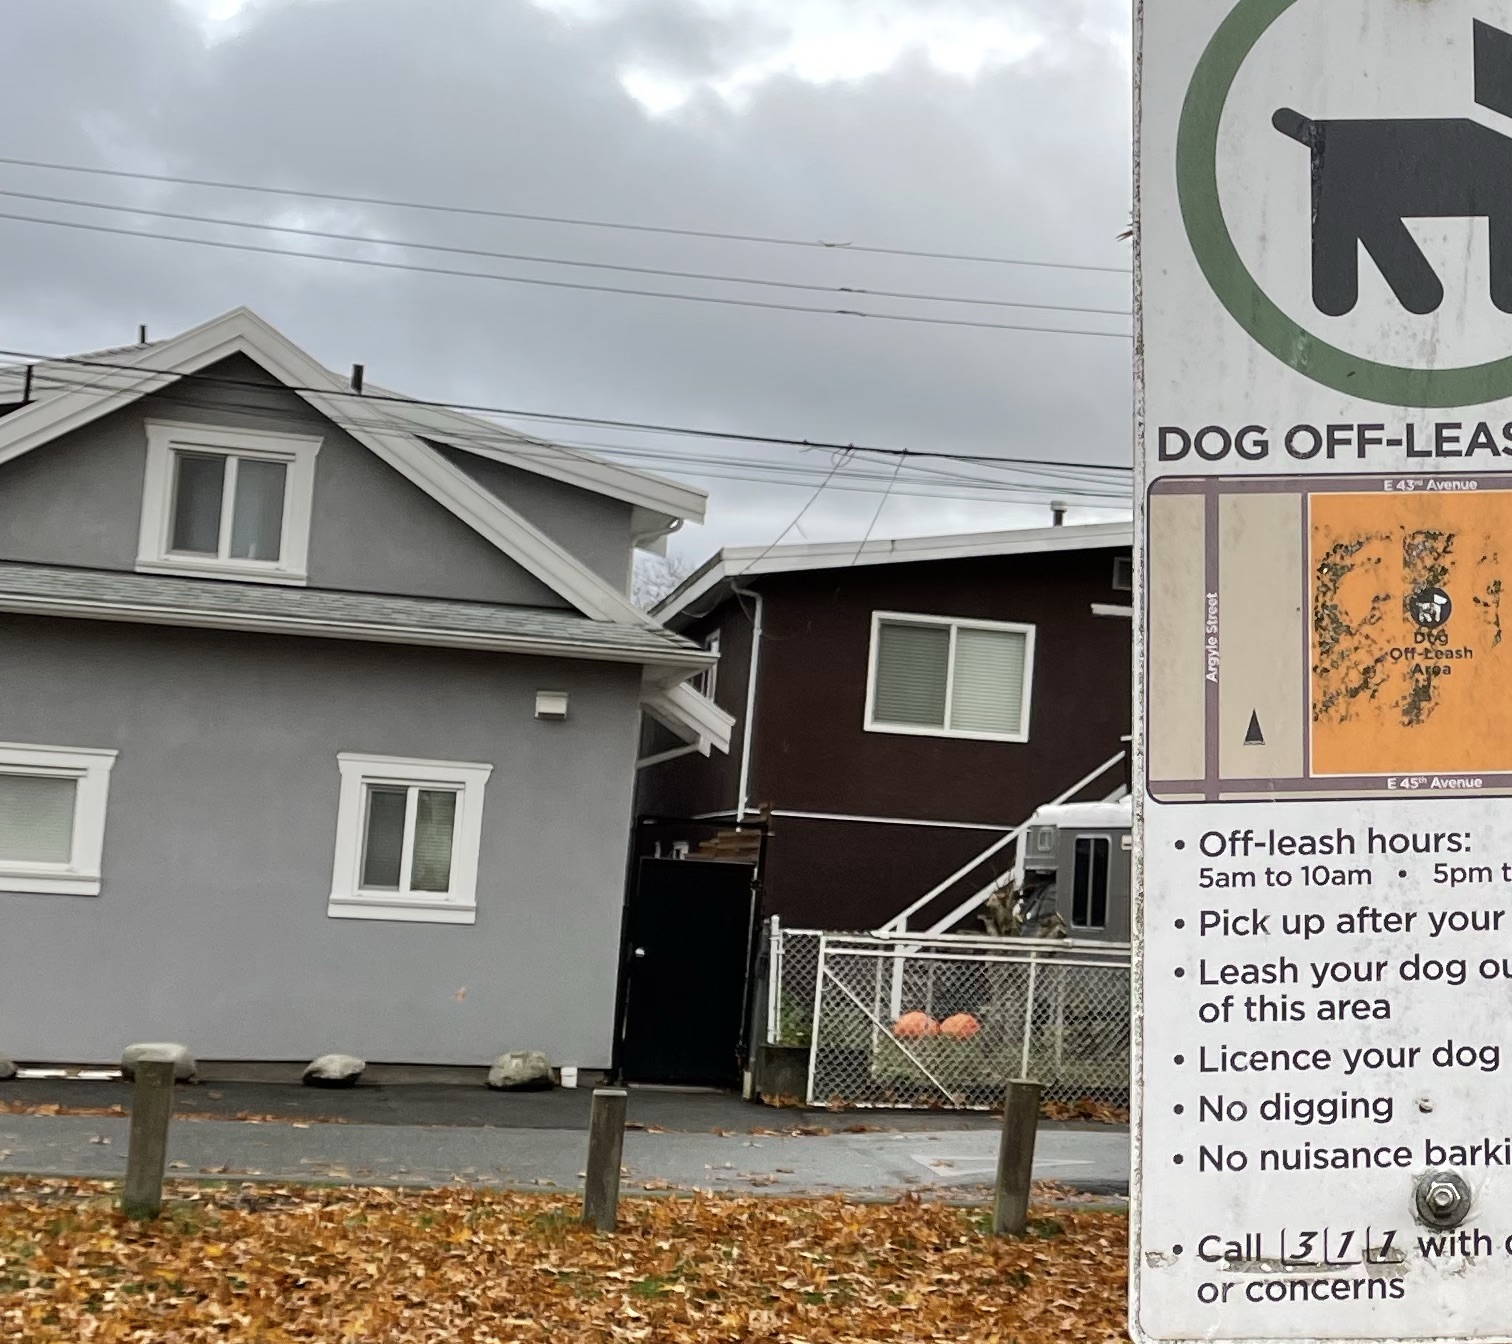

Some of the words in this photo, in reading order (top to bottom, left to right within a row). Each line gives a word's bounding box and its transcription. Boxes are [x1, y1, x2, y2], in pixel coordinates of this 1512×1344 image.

[1159, 425, 1268, 461] DOG
[1384, 480, 1393, 491] E
[1426, 479, 1478, 491] Avenue
[1205, 592, 1218, 633] Street
[1205, 636, 1219, 683] Argyle
[1390, 646, 1473, 660] Off-Leash
[1413, 663, 1451, 675] Area
[1387, 777, 1397, 789] E
[1430, 776, 1483, 788] Avenue
[1200, 828, 1354, 857] Off-leash
[1368, 827, 1470, 853] hours:
[1199, 868, 1255, 888] 5am
[1265, 868, 1292, 886] to
[1301, 866, 1371, 886] 10am
[1434, 863, 1492, 887] 5pm
[1201, 909, 1270, 936] Pick
[1283, 914, 1324, 940] up
[1337, 906, 1417, 933] after
[1428, 911, 1505, 937] your
[1200, 956, 1298, 985] Leash
[1311, 961, 1388, 988] your
[1400, 954, 1466, 985] dog
[1199, 995, 1233, 1023] of
[1245, 995, 1305, 1022] this
[1317, 999, 1390, 1020] area
[1200, 1046, 1331, 1072] Licence
[1343, 1047, 1420, 1075] your
[1433, 1040, 1499, 1072] dog
[1200, 1095, 1247, 1122] No
[1260, 1093, 1392, 1125] digging
[1200, 1145, 1247, 1172] No
[1261, 1147, 1412, 1170] nuisance
[1197, 1233, 1262, 1262] Call
[1416, 1227, 1491, 1258] with
[1197, 1282, 1236, 1304] or
[1245, 1276, 1405, 1302] concerns
